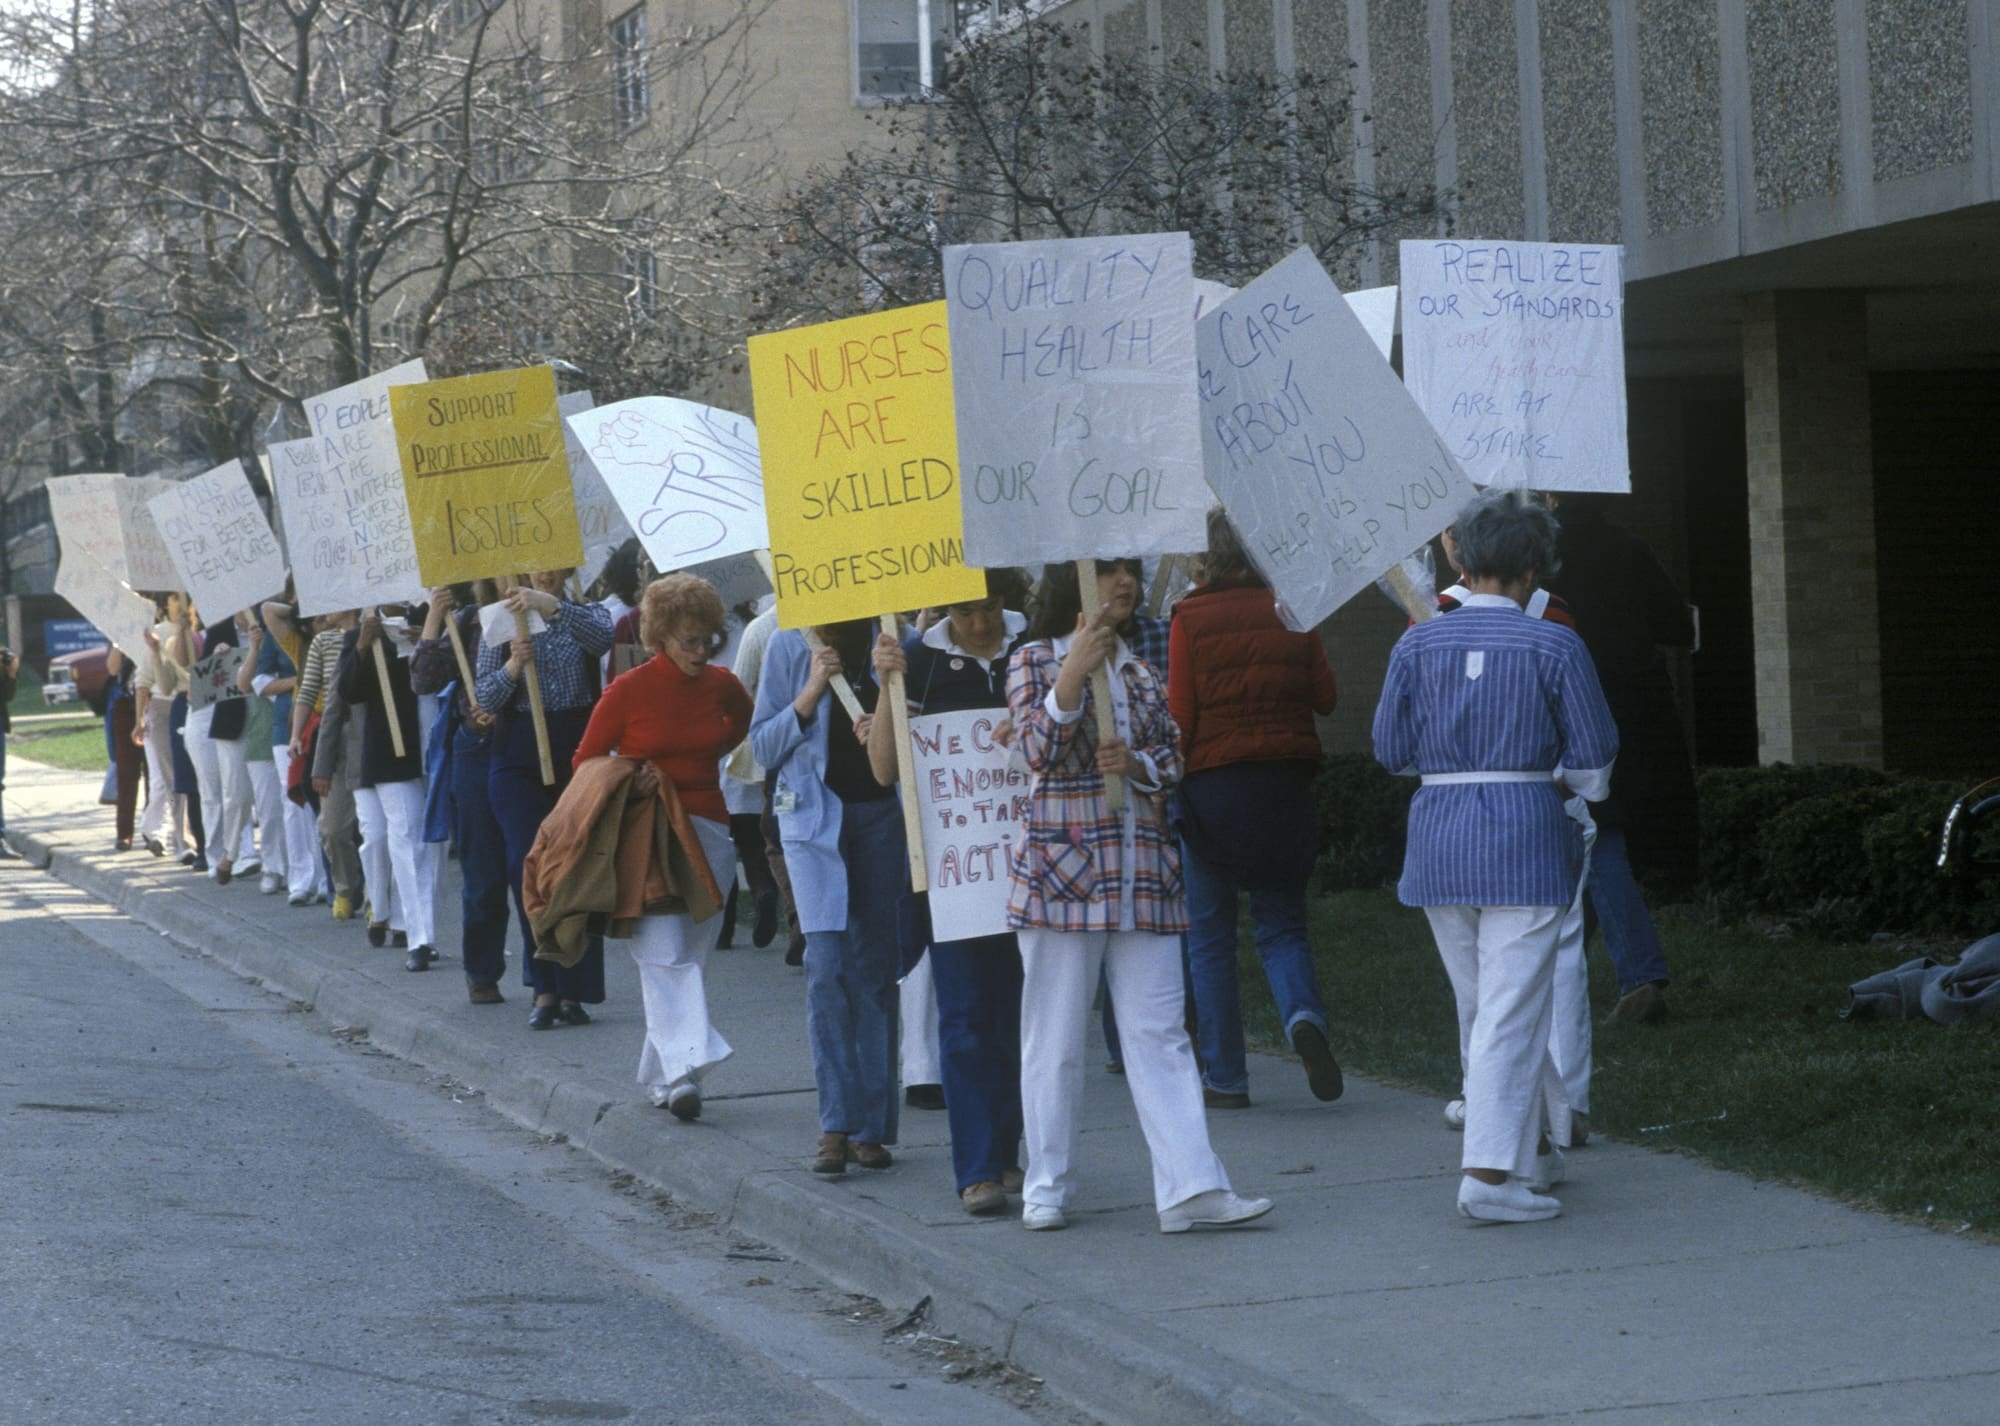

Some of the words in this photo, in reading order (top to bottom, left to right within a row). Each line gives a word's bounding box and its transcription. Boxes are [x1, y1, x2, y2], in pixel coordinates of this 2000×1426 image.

[958, 246, 1163, 320] QUALITY
[1434, 242, 1601, 286] REALIZE
[1219, 293, 1315, 368] CARE
[1418, 294, 1464, 319] OUR
[1482, 288, 1615, 323] STANDARDS
[784, 323, 948, 399] NURSES
[1000, 318, 1153, 384] HEALTH
[314, 394, 388, 436] PEOPLE
[427, 391, 518, 427] SUPPORT
[814, 395, 907, 459] ARE
[1051, 401, 1092, 448] IS
[1215, 359, 1313, 472] ABOUT
[1451, 391, 1503, 418] ARE
[1516, 389, 1553, 417] AT
[411, 432, 548, 474] PROFESSIONAL
[1288, 415, 1366, 498] YOU
[1454, 426, 1563, 461] STAKE
[343, 470, 402, 508] INTERE
[801, 457, 953, 521] SKILLED
[974, 460, 1040, 507] OUR
[1067, 457, 1180, 518] GOAL
[445, 498, 553, 556] ISSUES
[1263, 511, 1312, 567] HELP
[1325, 495, 1358, 519] US
[1331, 518, 1382, 576] HELP
[911, 723, 965, 758] WE
[938, 808, 968, 829] TO
[973, 794, 1027, 823] TAK
